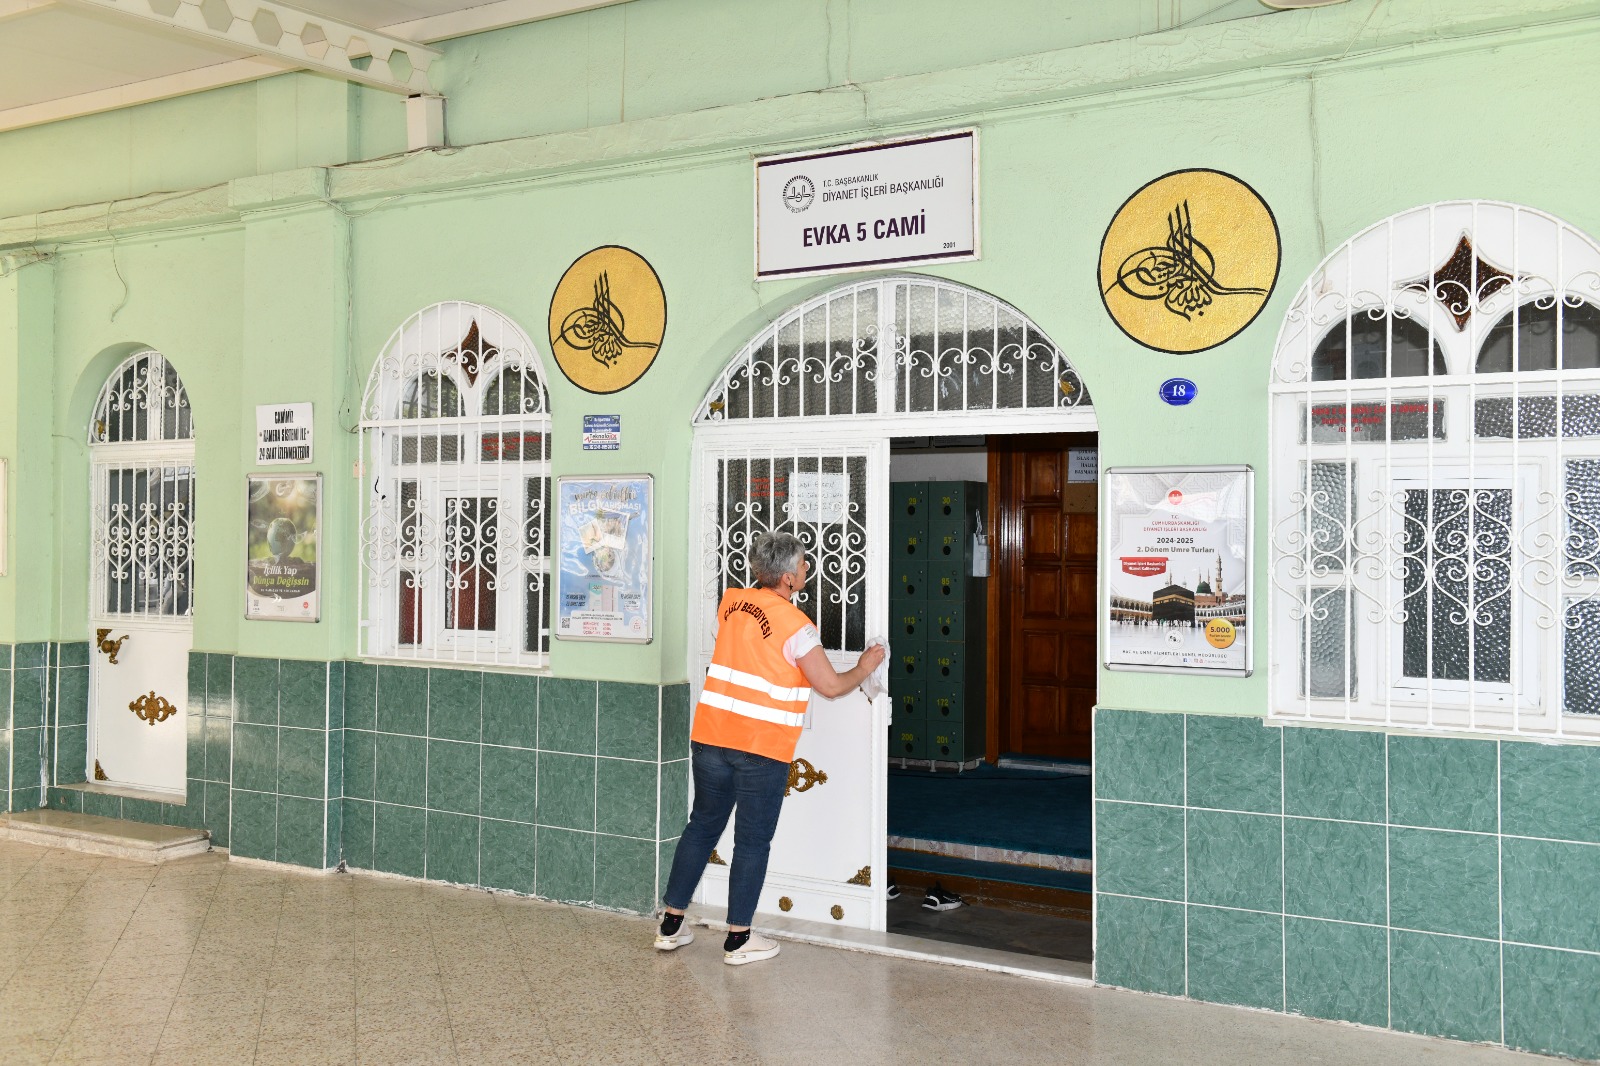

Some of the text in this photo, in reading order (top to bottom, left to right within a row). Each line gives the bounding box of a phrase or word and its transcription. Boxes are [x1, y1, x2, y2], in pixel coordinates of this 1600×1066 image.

[823, 173, 879, 188] T.C. BAŞBAKANLIK
[822, 175, 944, 203] DİYANET İŞLERİ BAŞKANLIĞI
[803, 208, 925, 247] EVKA 5 CAMİ
[943, 241, 956, 249] 2001
[1172, 384, 1186, 397] 18
[263, 426, 307, 442] KAMERA SİSTEMİ İLE
[259, 447, 265, 460] 24
[265, 447, 277, 460] SAAT
[908, 497, 917, 505] 29
[942, 496, 950, 505] 30
[908, 537, 917, 545] 56
[943, 536, 952, 544] 57
[283, 565, 297, 577] Yap
[276, 575, 310, 588] Değişsin
[941, 577, 950, 585] 85
[903, 616, 915, 625] 113
[903, 655, 915, 664] 142
[937, 657, 950, 666] 143
[903, 696, 914, 704] 171
[936, 698, 949, 707] 172
[901, 733, 914, 741] 200
[936, 735, 948, 744] 201
